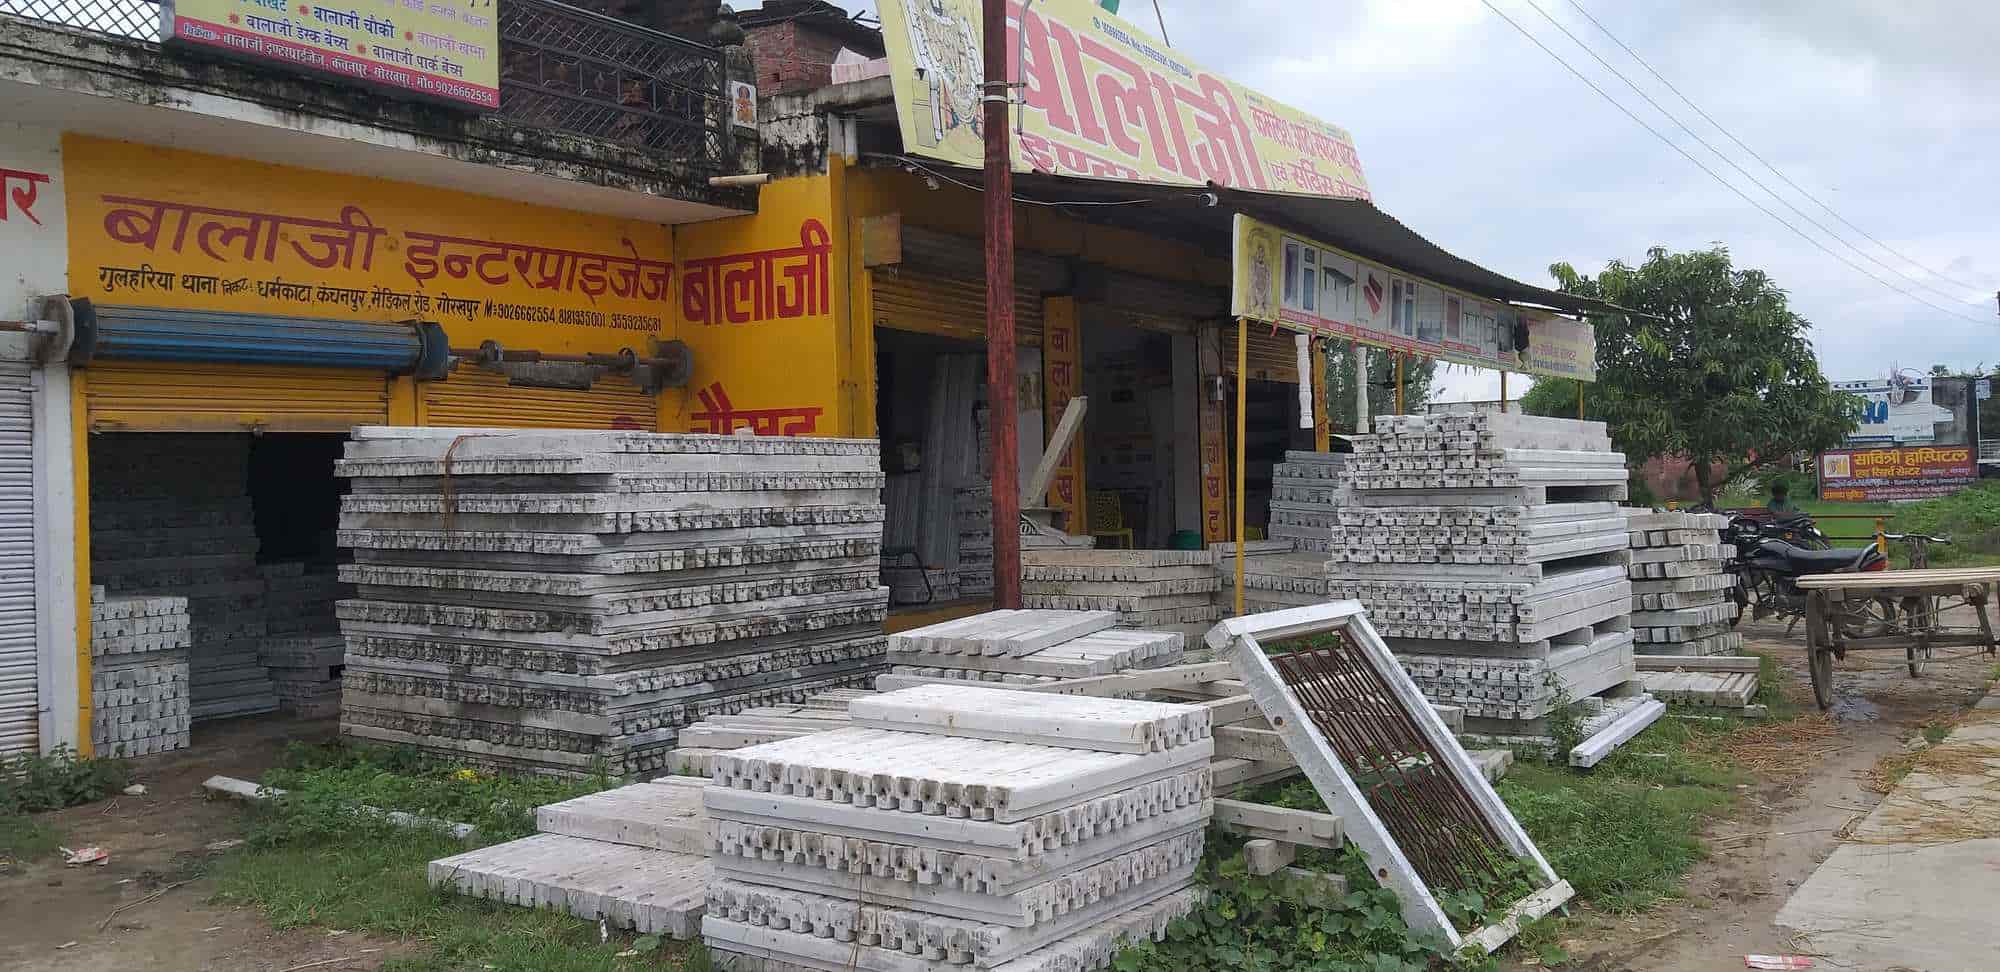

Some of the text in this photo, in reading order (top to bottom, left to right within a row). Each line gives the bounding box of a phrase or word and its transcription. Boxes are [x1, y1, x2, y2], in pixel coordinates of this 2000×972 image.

[245, 14, 293, 38] बालाजी
[372, 44, 413, 66] बालाजी
[313, 6, 360, 31] बालाजी
[0, 168, 50, 226] र
[102, 193, 674, 305] बालाजी इन्टरप्राइजेज
[682, 217, 833, 326] बालाजी
[181, 272, 220, 294] थाना
